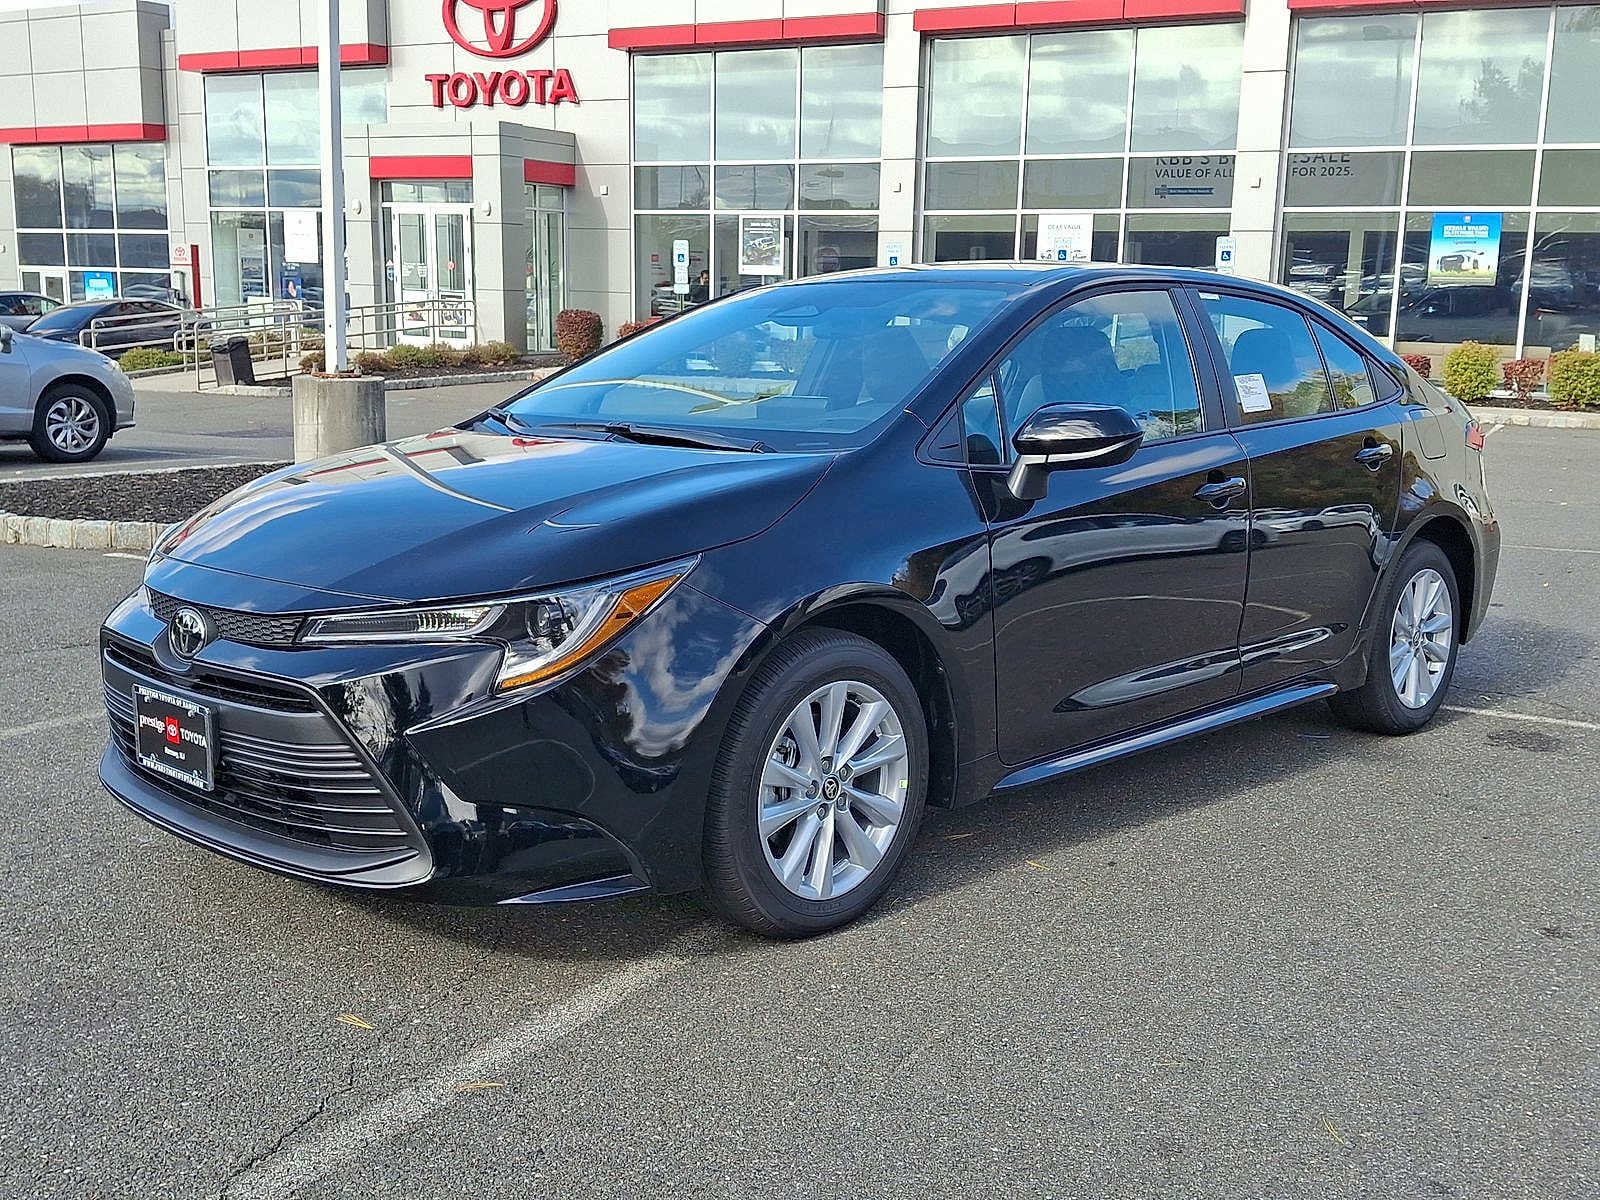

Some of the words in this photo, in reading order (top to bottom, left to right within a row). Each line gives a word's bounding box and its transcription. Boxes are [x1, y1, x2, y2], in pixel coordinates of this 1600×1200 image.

[425, 68, 579, 108] TOYOTA
[1155, 168, 1192, 178] VALUE
[1195, 168, 1211, 178] OF
[1214, 168, 1234, 178] ALL
[1292, 166, 1316, 177] FOR
[1320, 166, 1355, 176] 2025.
[139, 714, 166, 734] prestige
[180, 728, 207, 748] TOYOTA
